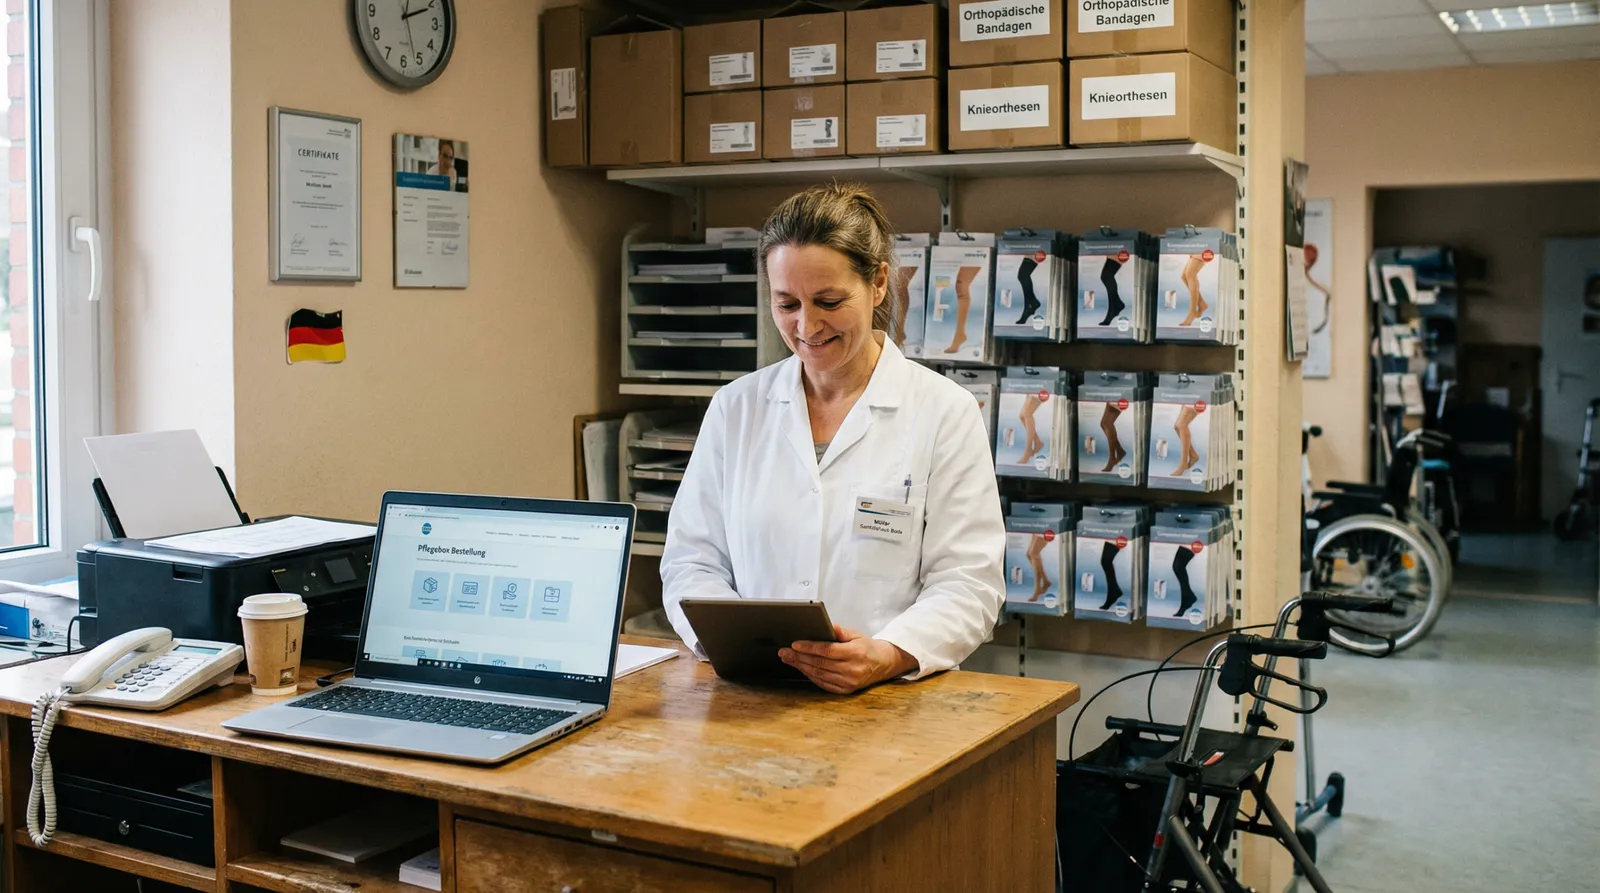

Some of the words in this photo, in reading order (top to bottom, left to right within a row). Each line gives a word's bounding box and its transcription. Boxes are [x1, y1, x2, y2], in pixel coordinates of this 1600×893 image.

[368, 3, 376, 17] 9
[964, 4, 1045, 21] Orthopädische
[431, 17, 438, 31] 3
[1096, 13, 1155, 25] Bandagen
[373, 26, 380, 41] 8
[976, 20, 1032, 34] Bandagen
[427, 38, 434, 51] 4
[385, 46, 392, 60] 7
[416, 52, 423, 66] 5
[400, 55, 407, 68] 6
[1089, 90, 1168, 104] Knieorthesen
[967, 102, 1041, 115] Knieorthesen
[417, 544, 450, 555] Pflegebox
[451, 546, 486, 558] Bestellung
